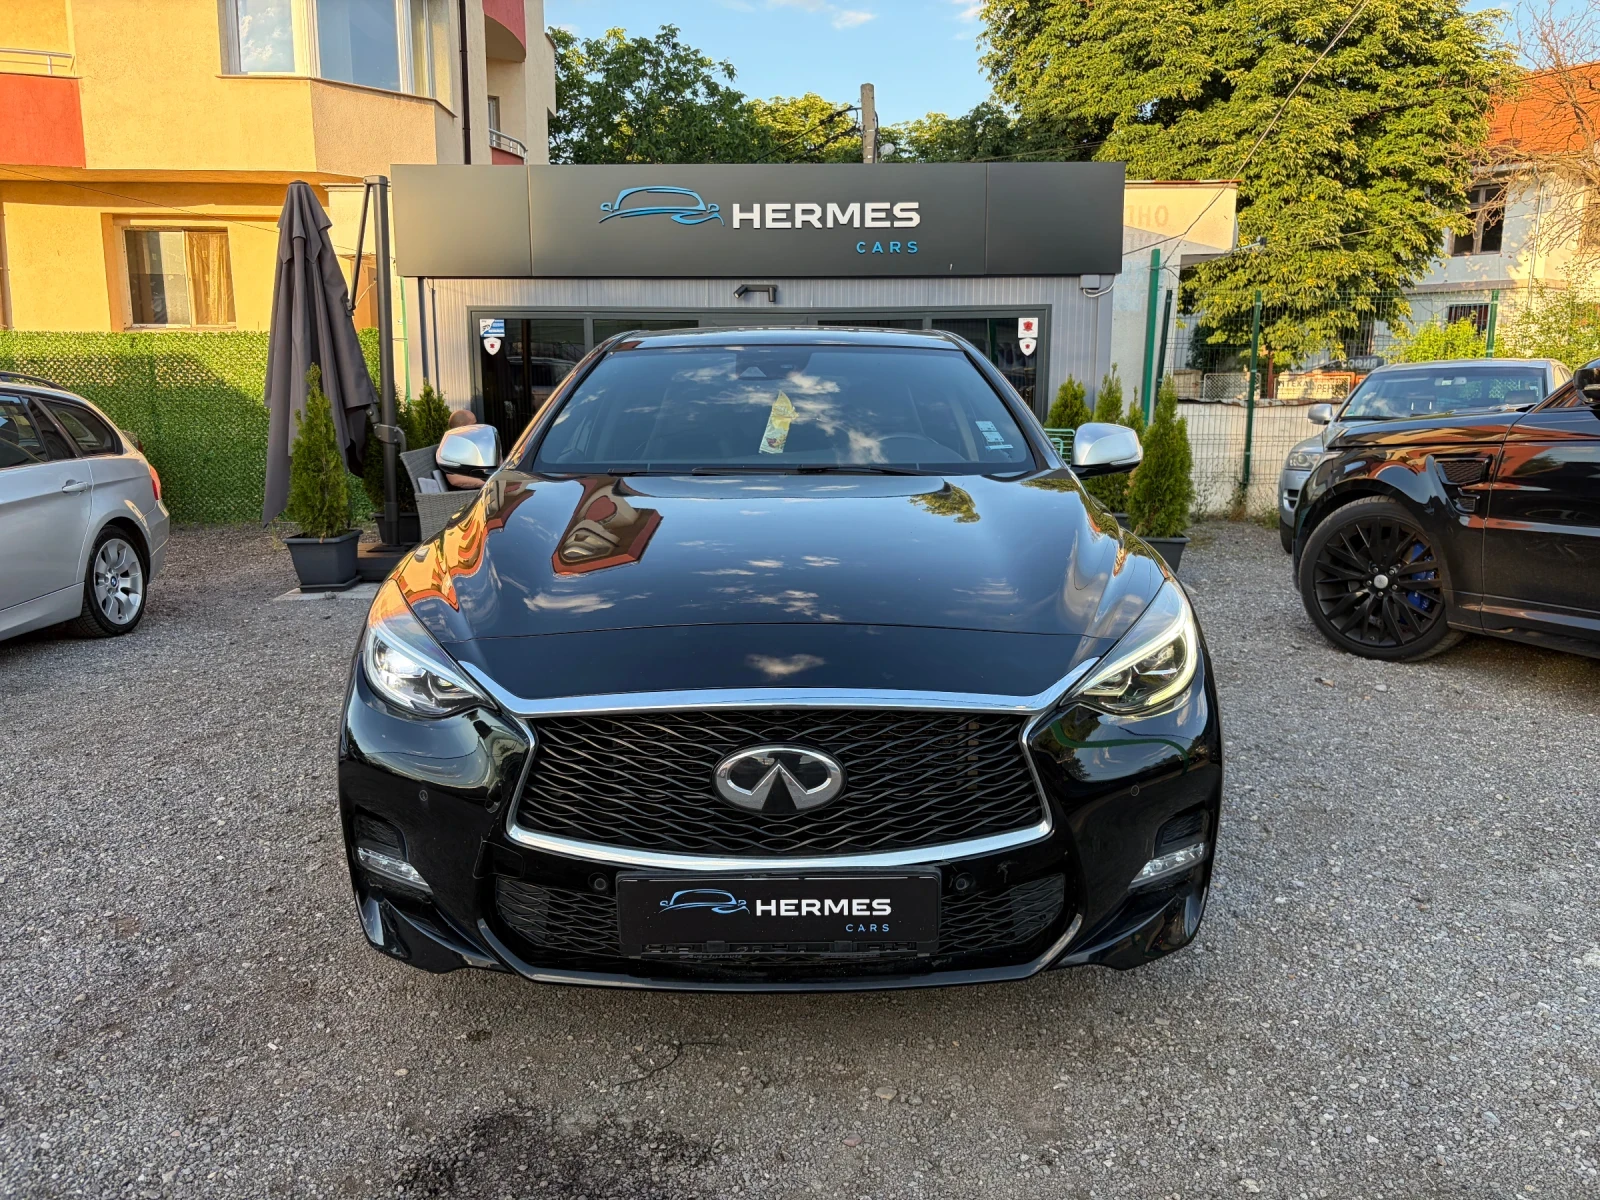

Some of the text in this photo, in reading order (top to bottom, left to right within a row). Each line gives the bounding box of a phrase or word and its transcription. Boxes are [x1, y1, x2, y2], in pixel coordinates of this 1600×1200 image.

[732, 202, 921, 229] HERMES
[856, 241, 919, 254] CARS
[755, 898, 892, 916] HERMES
[845, 923, 890, 932] CARS
